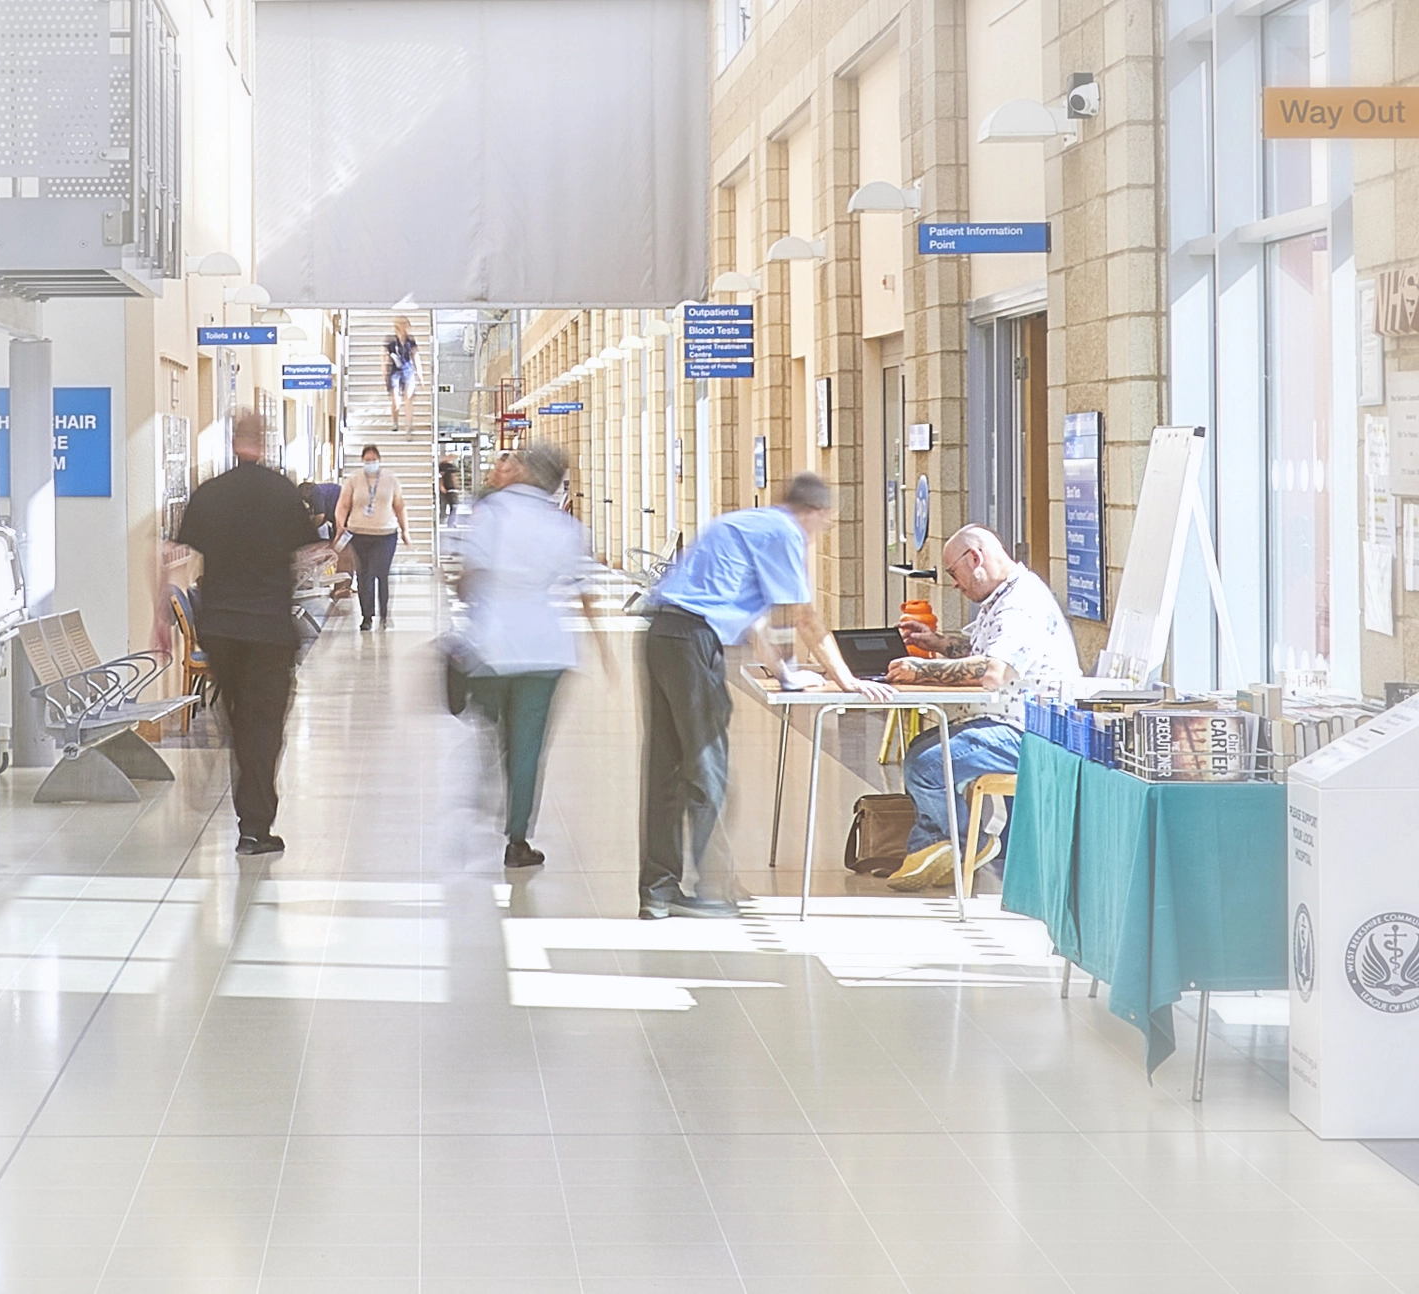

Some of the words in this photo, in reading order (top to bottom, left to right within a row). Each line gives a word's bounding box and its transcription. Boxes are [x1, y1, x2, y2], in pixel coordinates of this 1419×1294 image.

[1279, 99, 1343, 130] Way
[1353, 98, 1406, 124] Out
[929, 226, 964, 237] Patient
[966, 226, 1023, 236] Information
[929, 240, 956, 249] Point
[688, 308, 739, 318] Outpatients
[205, 332, 228, 340] Toilets
[688, 326, 714, 335] Blood
[716, 326, 740, 335] Tests
[284, 366, 330, 374] Physiotherapy
[1156, 716, 1172, 777] EXECUTIONER
[1211, 719, 1228, 776] CARTER
[1383, 914, 1419, 926] COMMU
[1350, 916, 1382, 948] BERKSHIRE
[1346, 951, 1355, 973] WEST
[1360, 991, 1387, 1011] LEAGUE
[1389, 1003, 1400, 1012] OF
